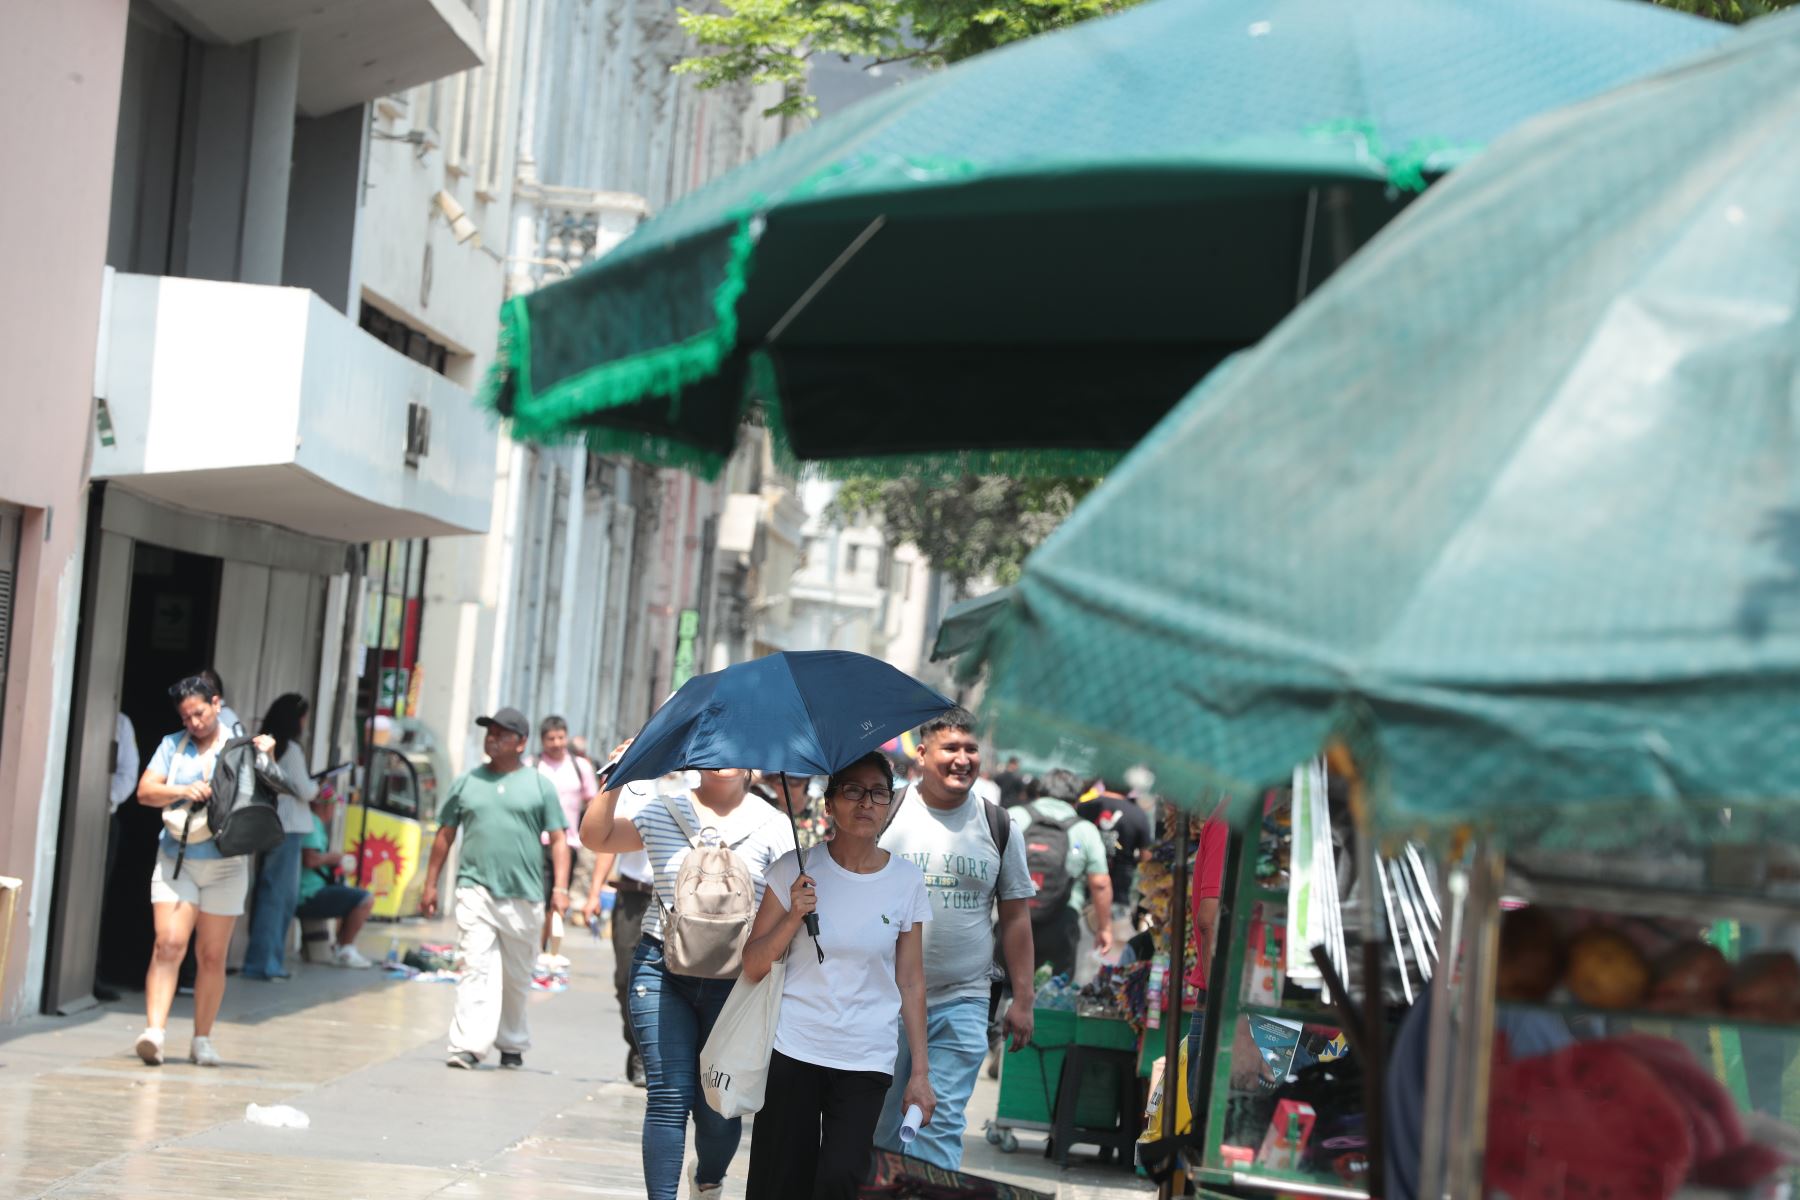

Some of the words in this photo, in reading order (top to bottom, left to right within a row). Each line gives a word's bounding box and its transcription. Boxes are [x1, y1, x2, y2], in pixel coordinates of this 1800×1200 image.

[860, 720, 873, 731] UV
[942, 854, 988, 881] YORK
[941, 891, 980, 909] YORK
